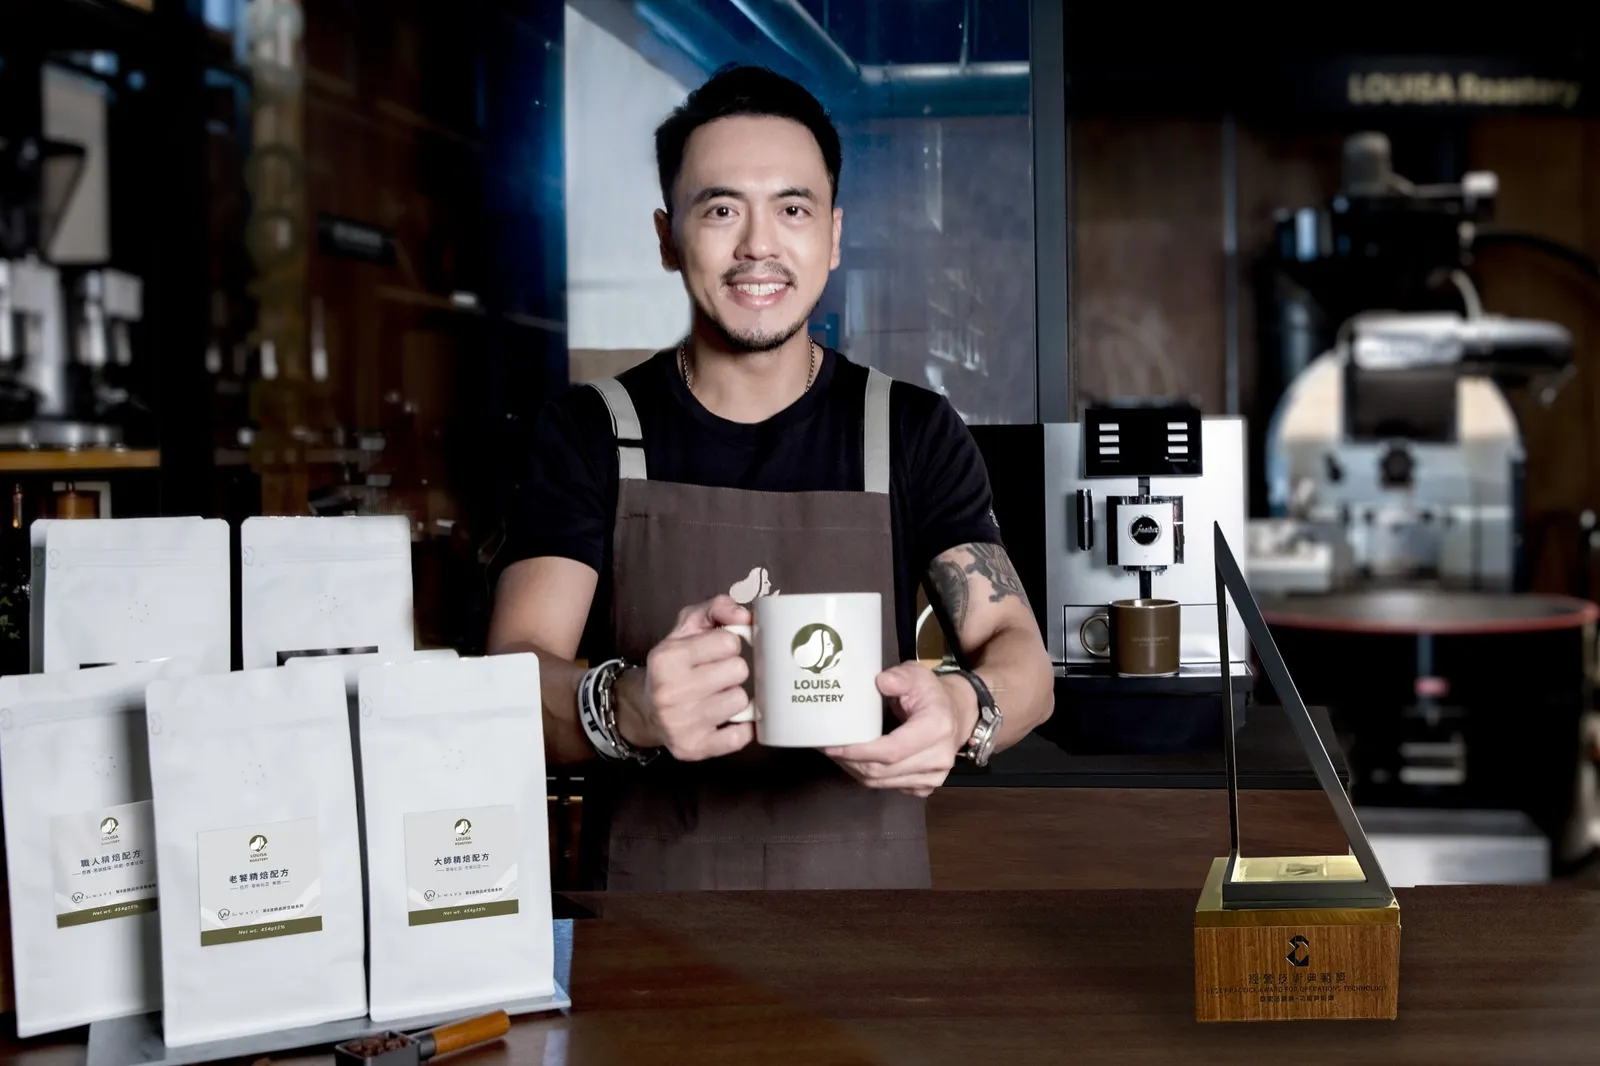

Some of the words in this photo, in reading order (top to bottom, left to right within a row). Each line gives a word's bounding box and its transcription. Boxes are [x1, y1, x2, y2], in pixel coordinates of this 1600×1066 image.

[1348, 73, 1456, 104] LOUISA
[1458, 73, 1580, 109] Roastery
[793, 679, 842, 690] LOUISA
[791, 693, 845, 703] ROASTERY
[80, 849, 141, 868] 職人精焙配方
[433, 853, 490, 866] 大師精焙配方
[238, 928, 249, 936] Net
